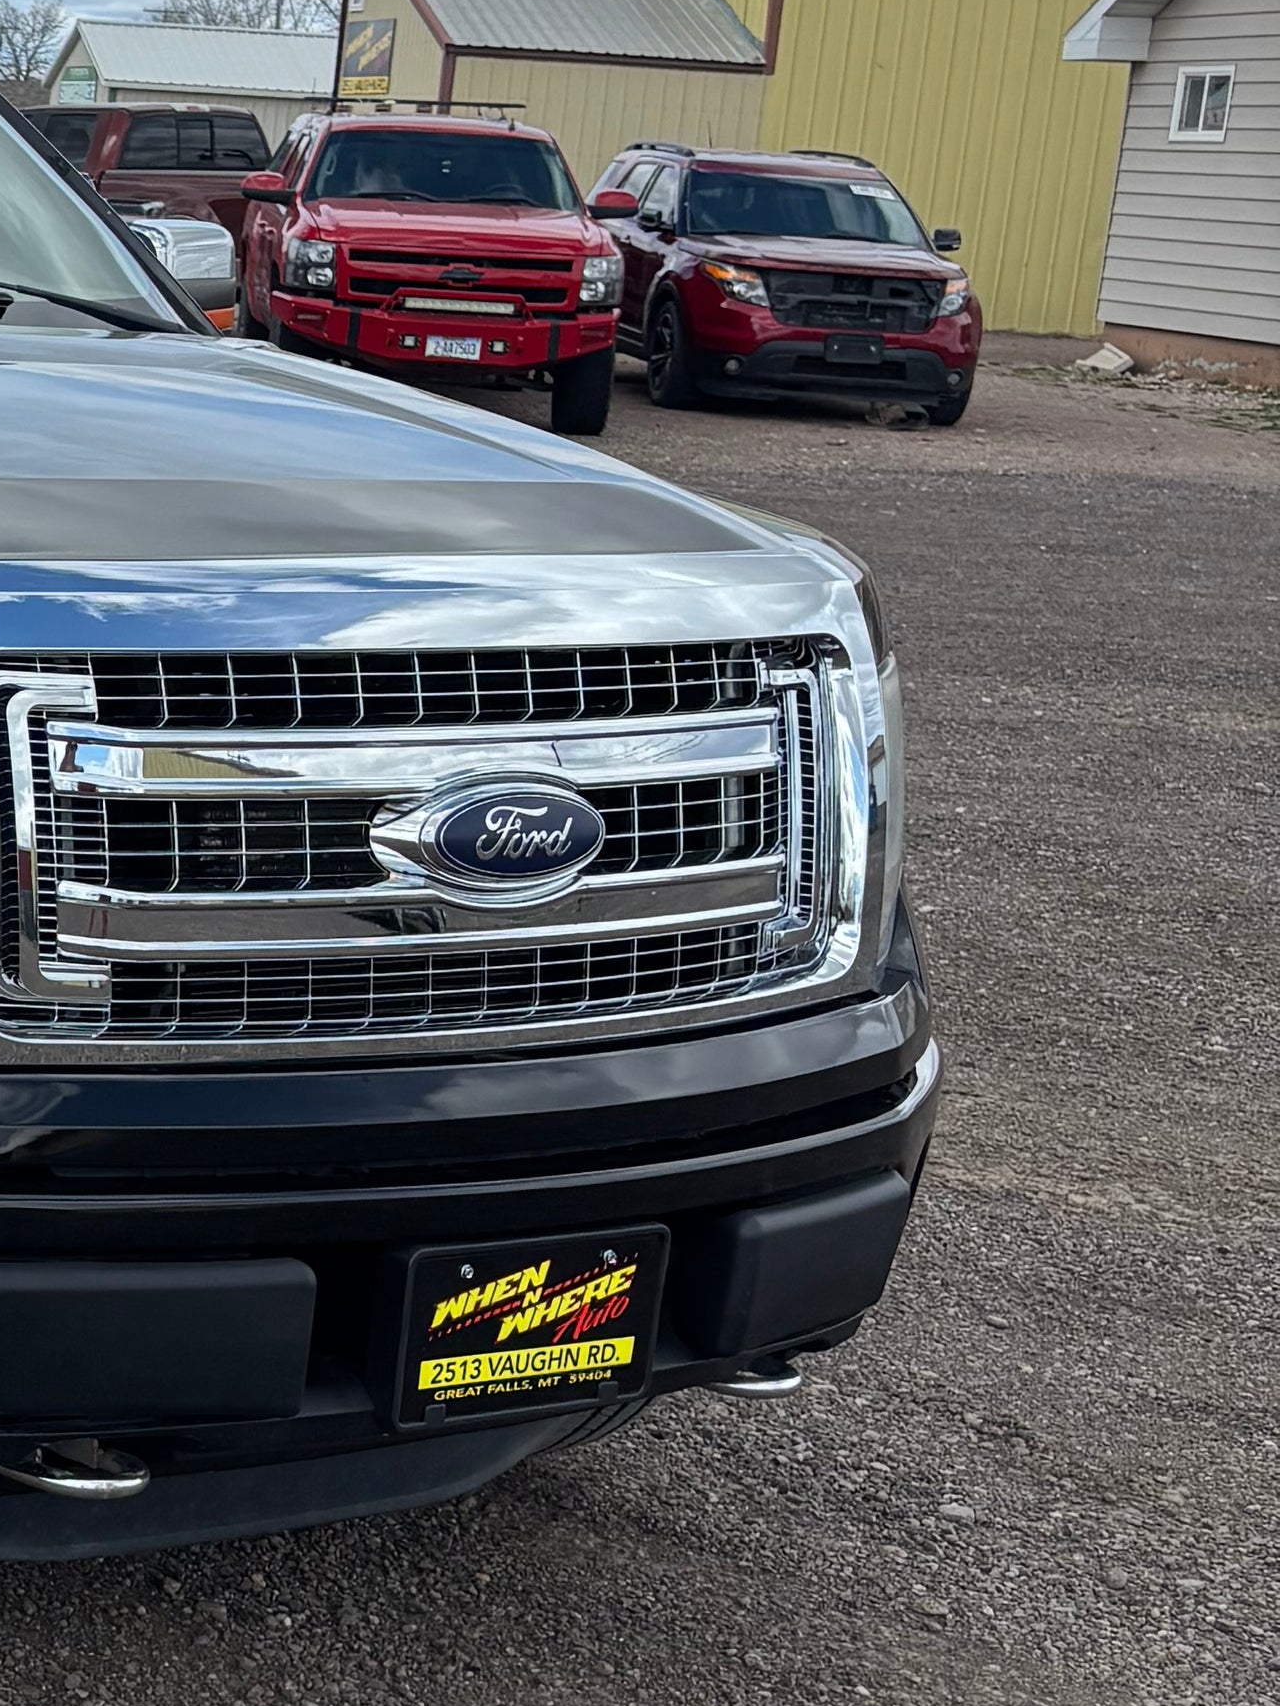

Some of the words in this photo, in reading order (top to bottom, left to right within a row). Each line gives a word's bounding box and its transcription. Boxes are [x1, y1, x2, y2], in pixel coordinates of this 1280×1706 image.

[476, 805, 573, 861] Ford
[431, 1259, 551, 1329] WHEN
[494, 1264, 637, 1344] WHERE
[522, 1287, 543, 1308] N
[551, 1295, 630, 1344] Auto
[430, 1358, 482, 1385] 2513
[488, 1347, 581, 1377] VAUGHN
[586, 1343, 620, 1366] RD.
[433, 1384, 483, 1401] GREAT
[538, 1375, 561, 1388] MT
